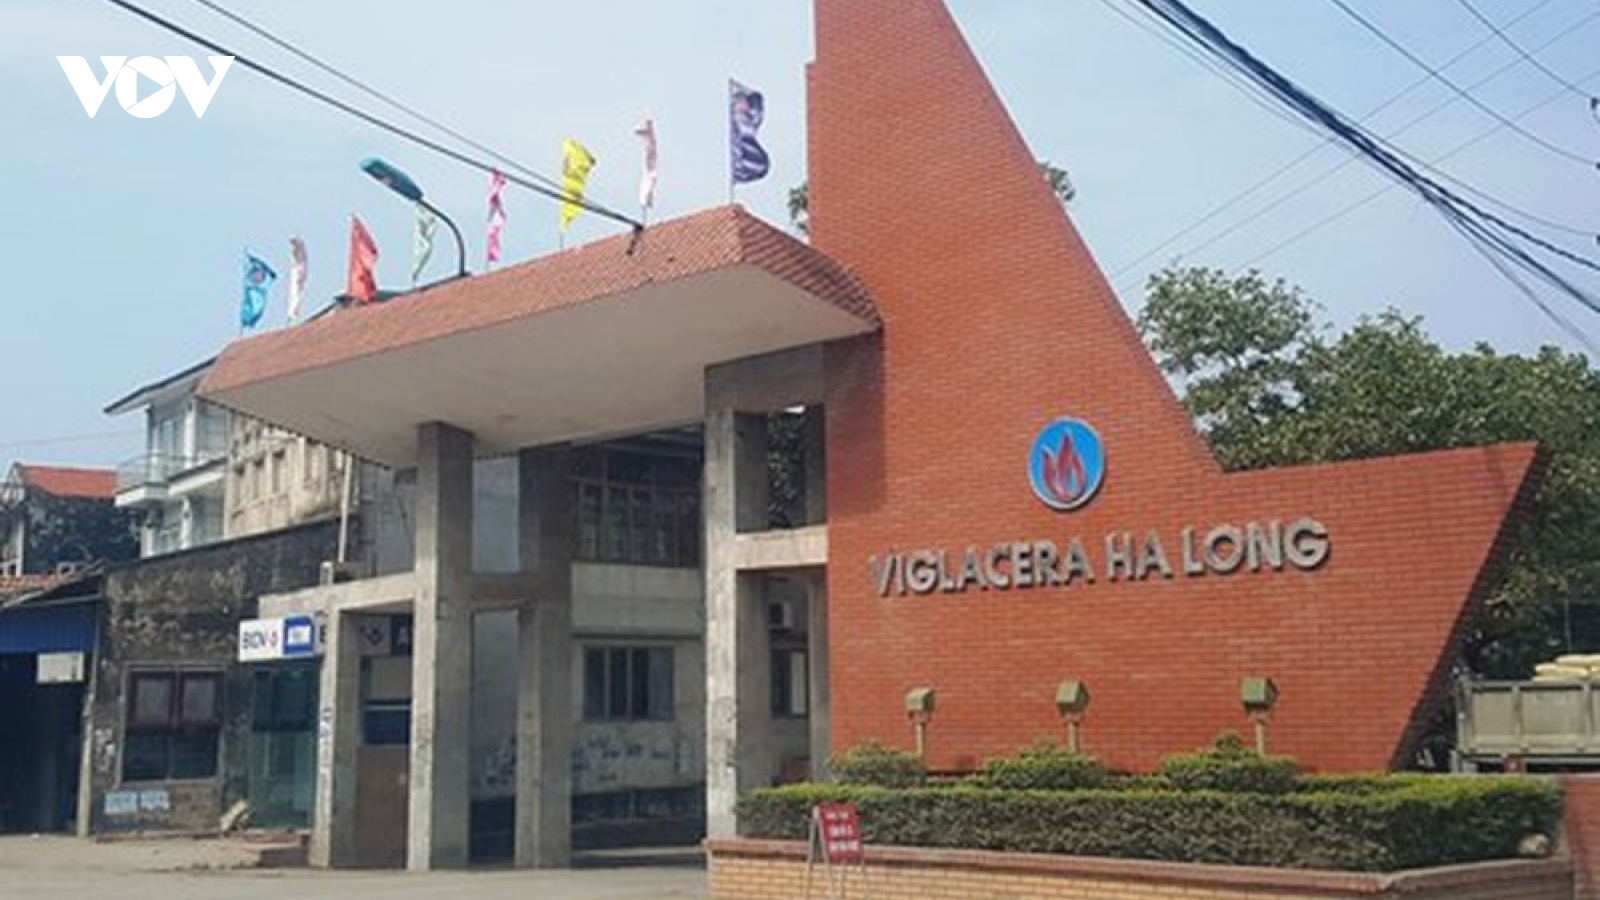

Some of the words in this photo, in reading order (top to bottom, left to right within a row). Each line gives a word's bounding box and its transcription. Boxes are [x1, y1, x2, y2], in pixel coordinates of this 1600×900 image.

[870, 537, 1094, 596] VIGLACERA
[1105, 530, 1173, 582] HA
[1182, 517, 1331, 577] LONG
